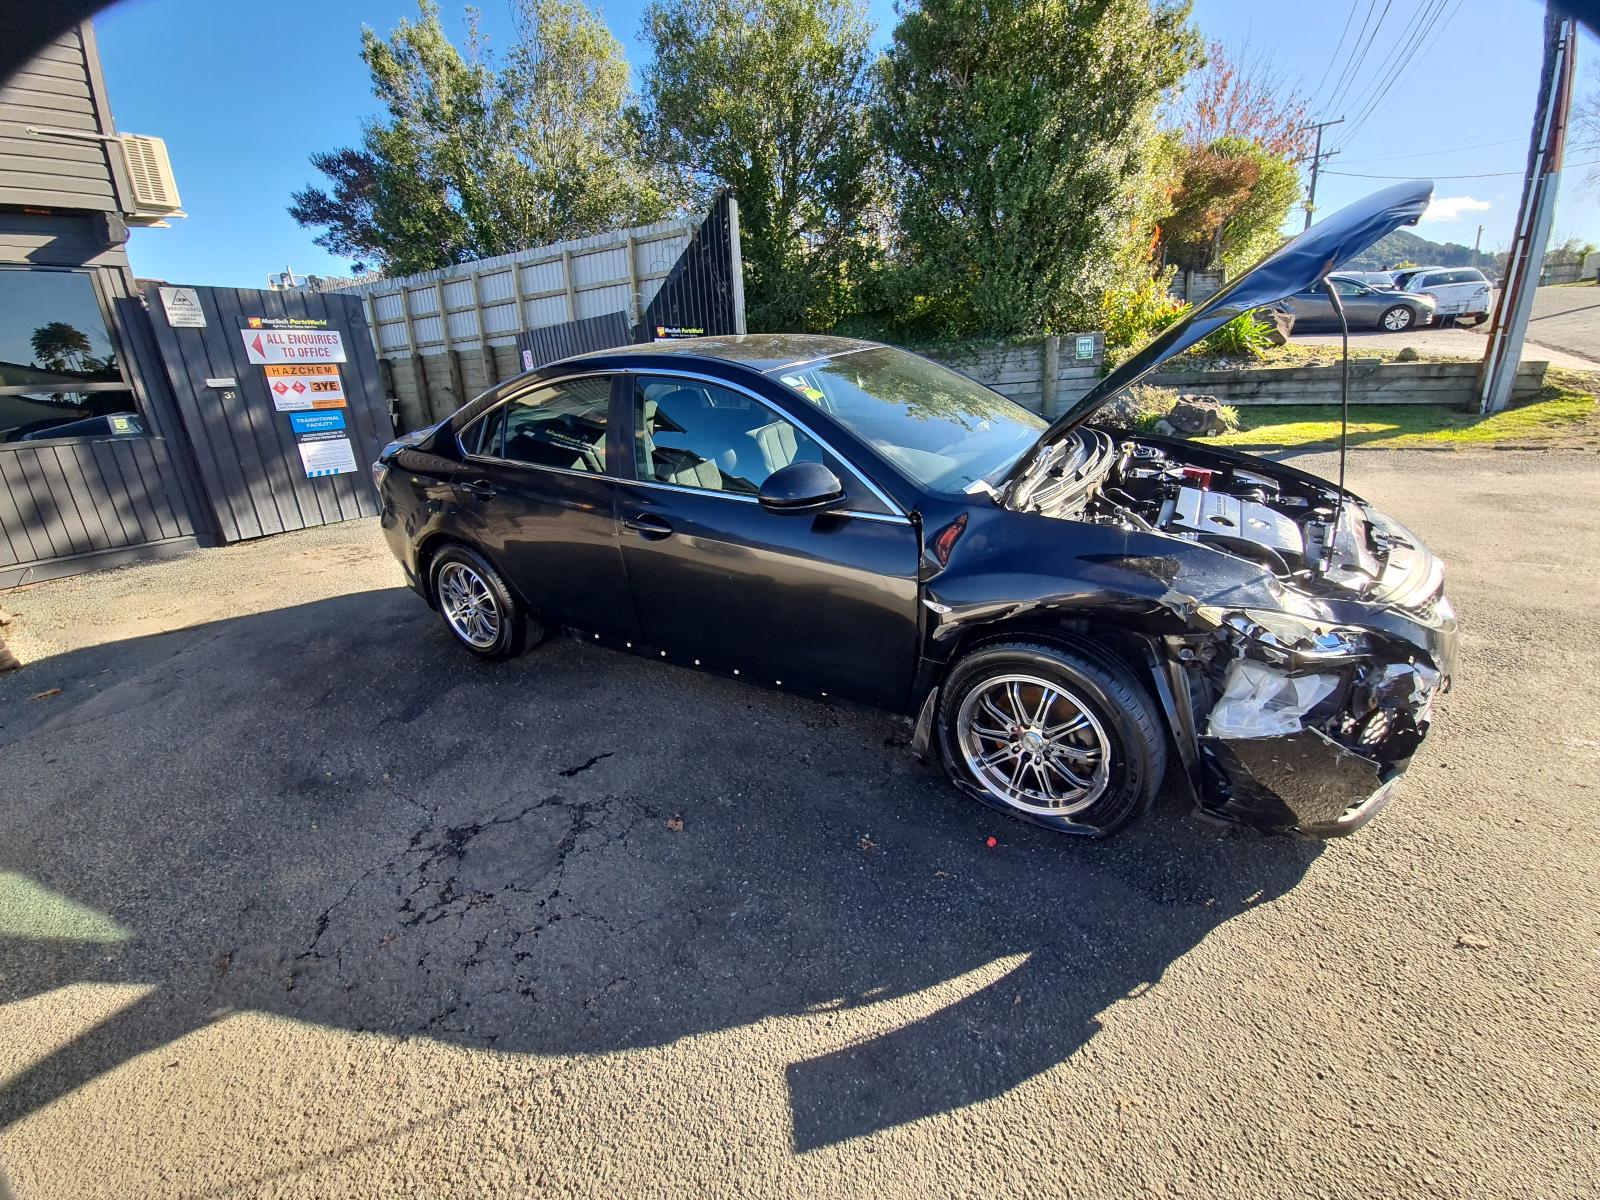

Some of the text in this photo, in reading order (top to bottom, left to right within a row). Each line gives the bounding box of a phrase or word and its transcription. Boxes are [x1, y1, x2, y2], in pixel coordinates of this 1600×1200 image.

[289, 318, 327, 326] PartsWorld
[266, 334, 339, 345] ALL ENQUIRIES
[282, 347, 331, 358] TO OFFICE
[272, 366, 332, 375] HAZCHEM
[313, 382, 338, 391] 3YE
[223, 391, 236, 400] 31
[296, 415, 340, 423] TRANSITIONAL
